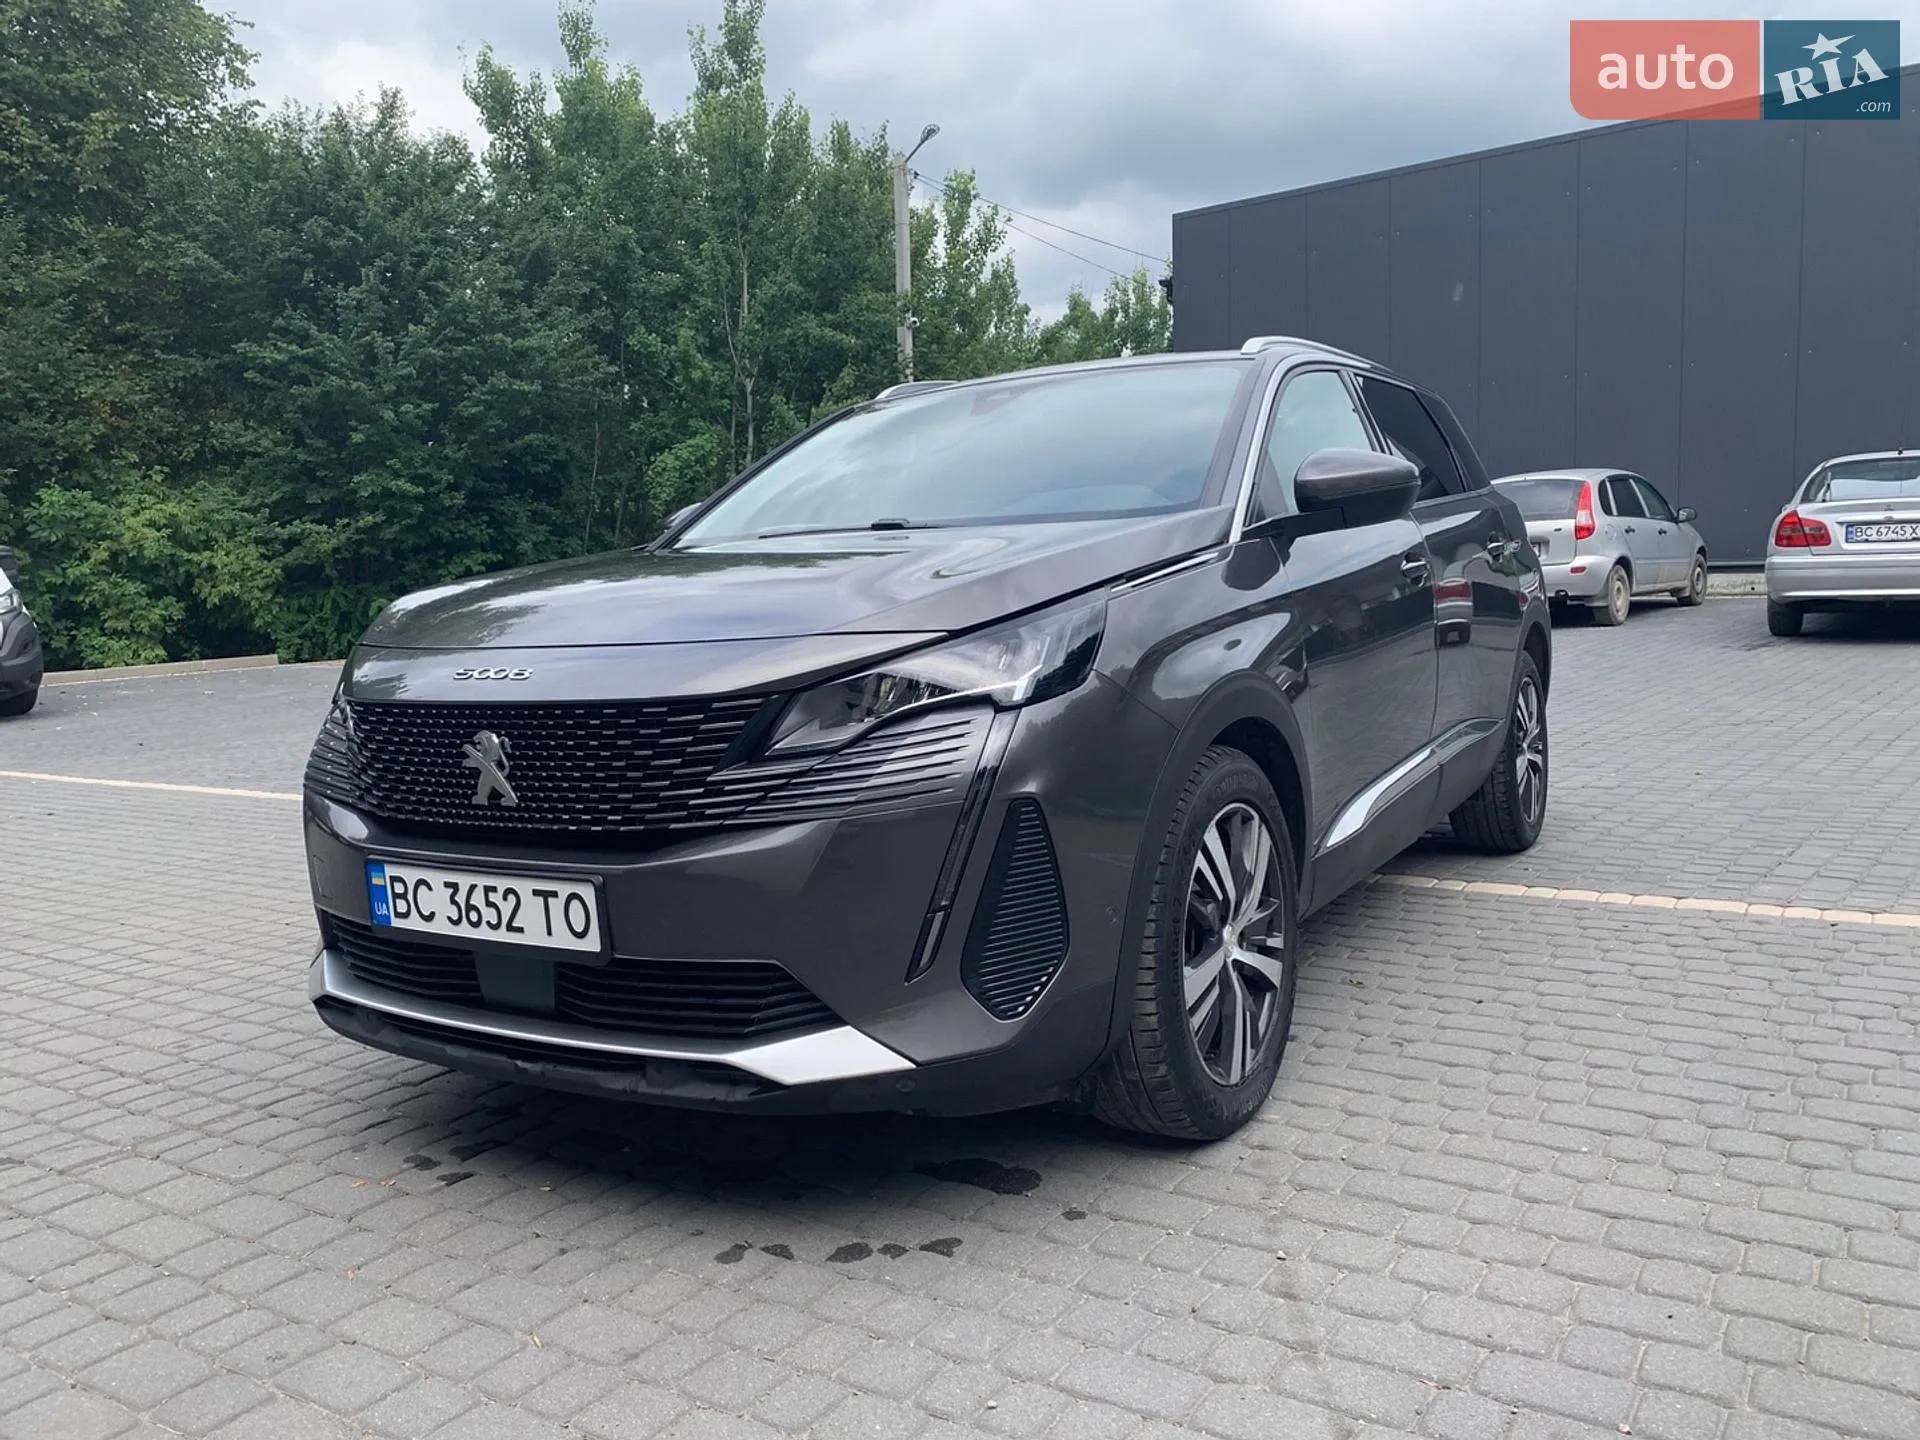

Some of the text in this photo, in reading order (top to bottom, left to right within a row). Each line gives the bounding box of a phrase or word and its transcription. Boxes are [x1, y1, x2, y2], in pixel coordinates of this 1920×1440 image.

[1855, 526, 1873, 537] BC
[1876, 525, 1907, 537] 6745
[374, 901, 389, 916] UA
[389, 874, 592, 940] BC 3652 TO
